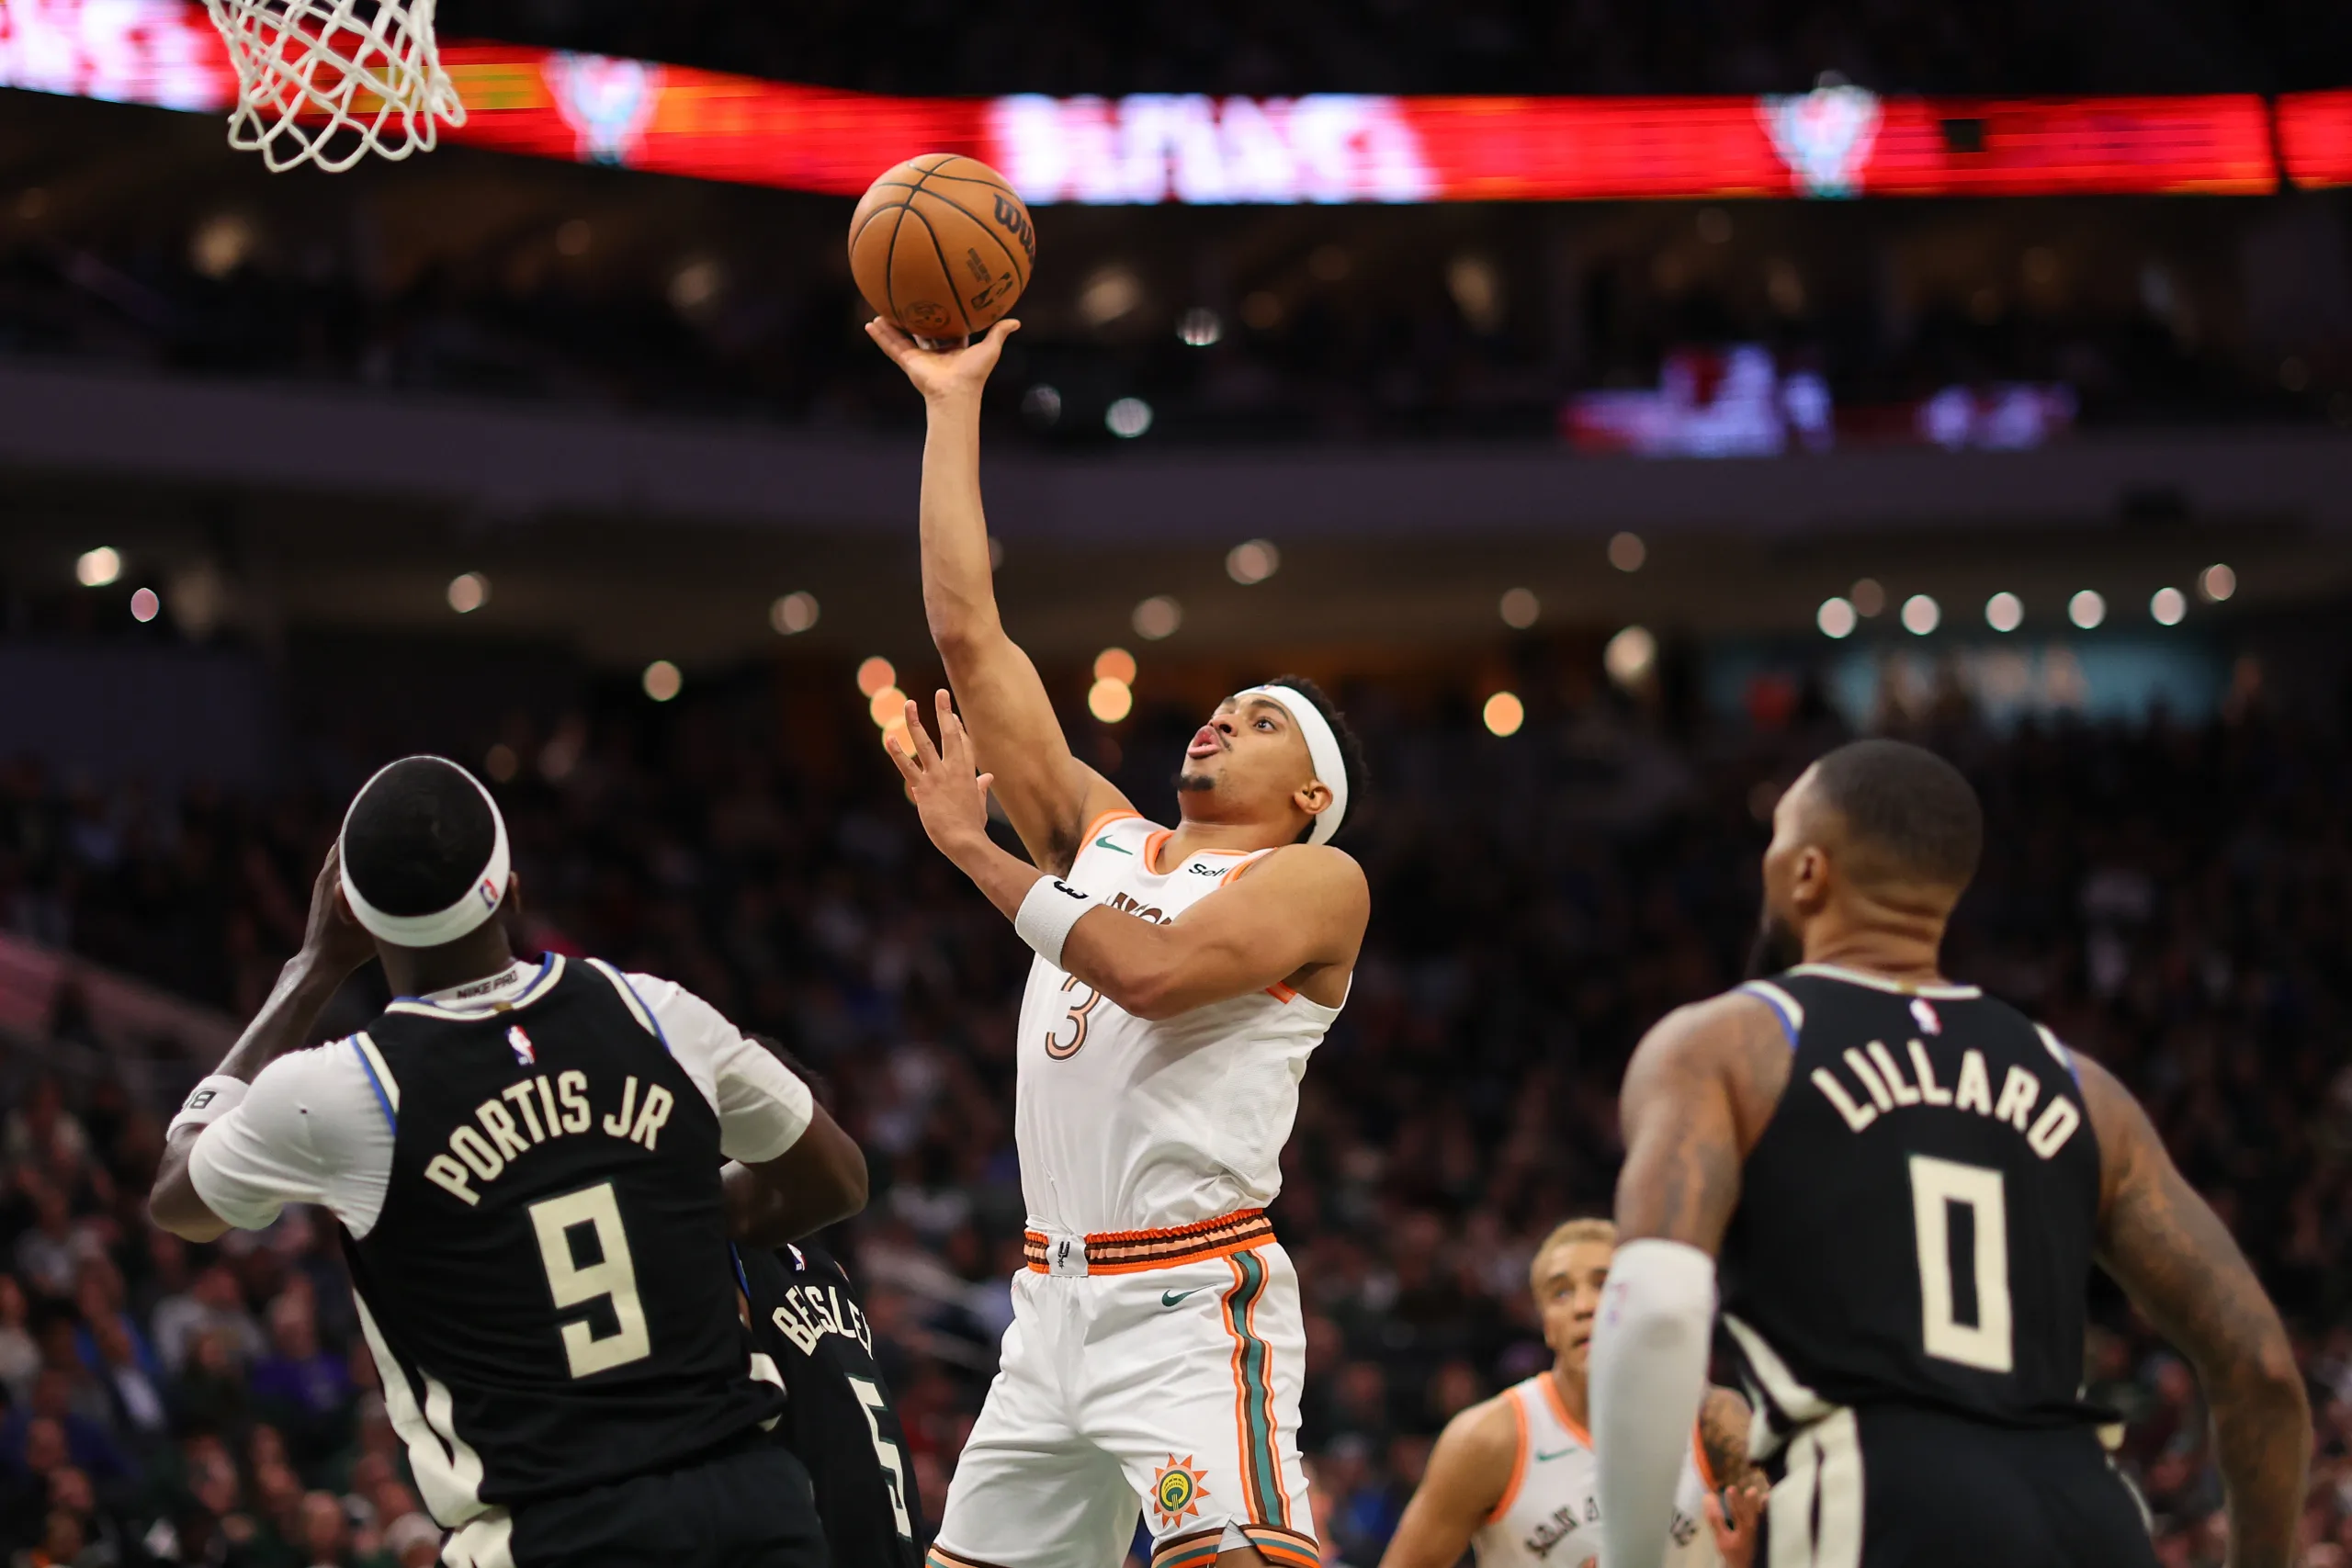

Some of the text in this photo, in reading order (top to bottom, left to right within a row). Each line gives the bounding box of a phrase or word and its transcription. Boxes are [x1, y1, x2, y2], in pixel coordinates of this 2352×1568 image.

[1045, 976, 1101, 1062] 3
[424, 1069, 674, 1206] PORTIS JR
[1811, 1039, 2080, 1160] LILLARD
[528, 1181, 650, 1379] 9
[1909, 1154, 2013, 1373] 0
[847, 1375, 912, 1540] 5
